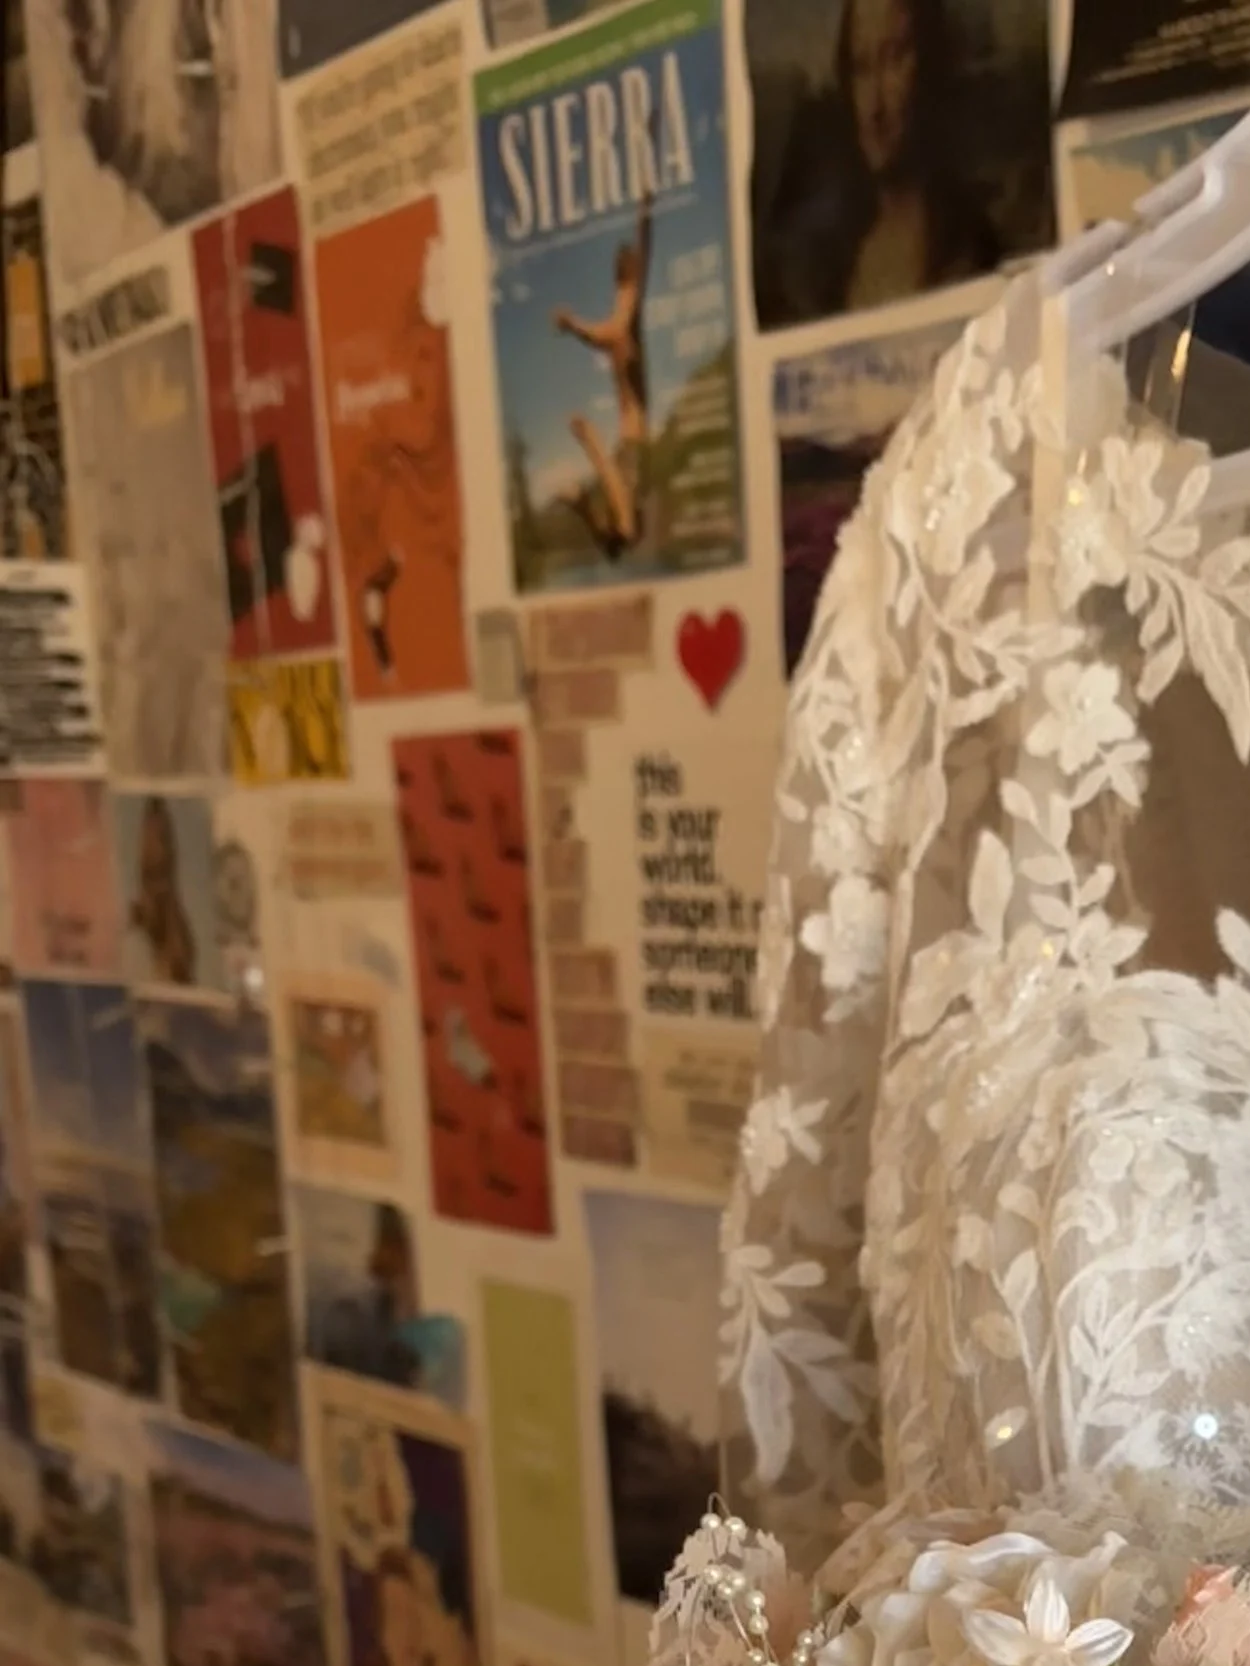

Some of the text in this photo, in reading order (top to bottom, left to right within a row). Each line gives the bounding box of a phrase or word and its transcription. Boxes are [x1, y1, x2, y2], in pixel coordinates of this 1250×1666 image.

[500, 52, 694, 241] SIERRA
[635, 753, 682, 797] this
[667, 807, 721, 850] your
[641, 892, 717, 936] shape
[644, 980, 695, 1018] else
